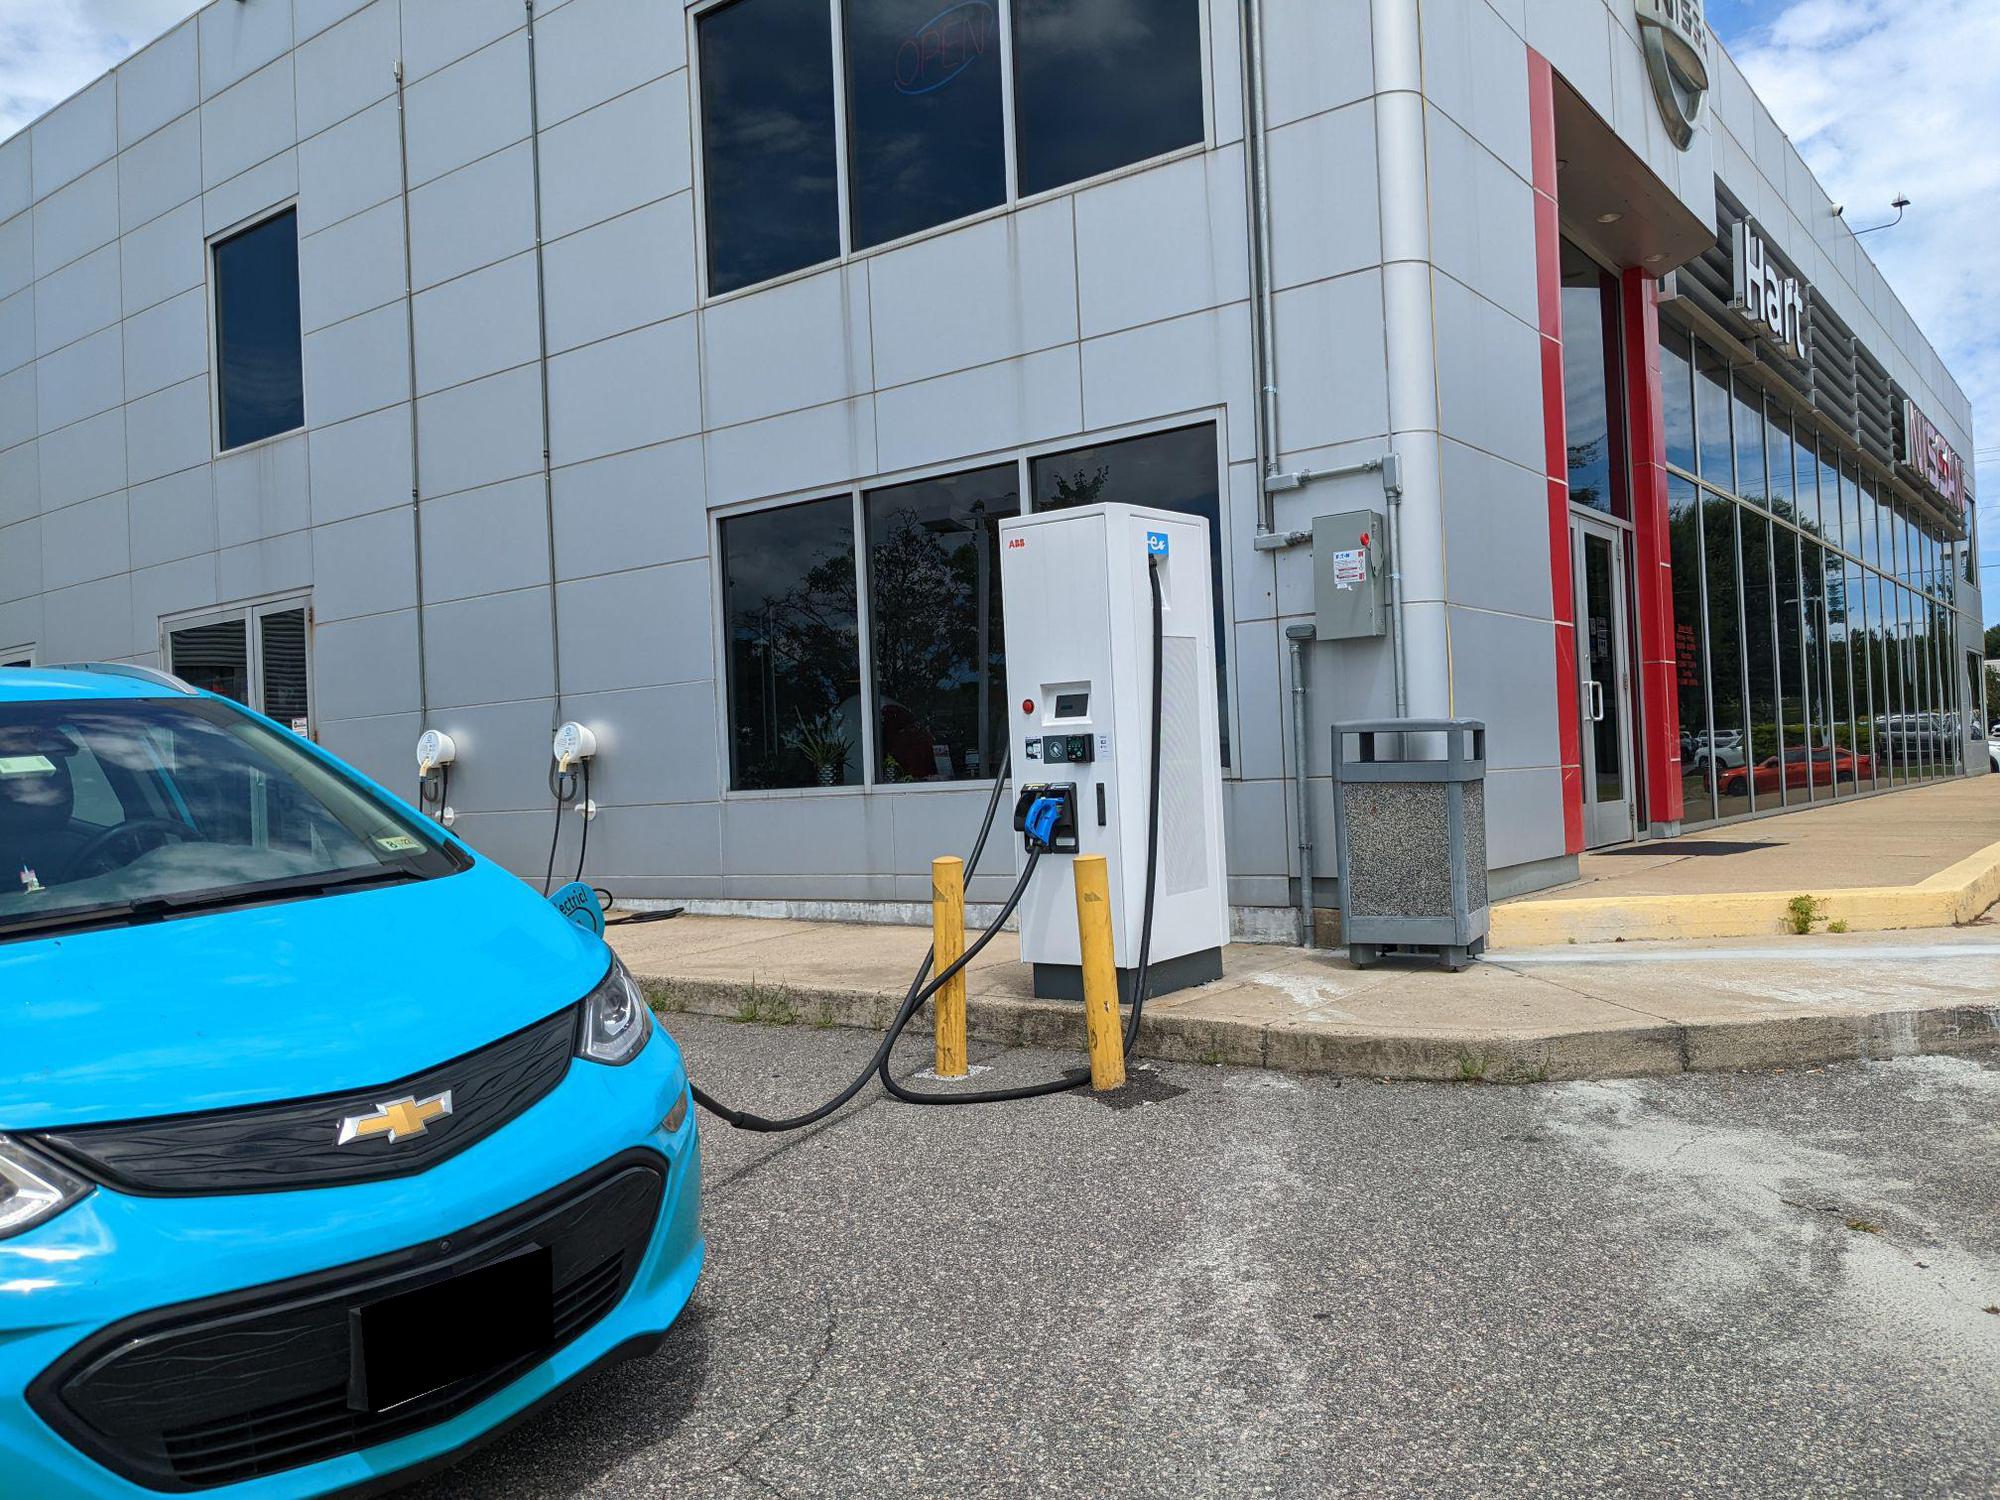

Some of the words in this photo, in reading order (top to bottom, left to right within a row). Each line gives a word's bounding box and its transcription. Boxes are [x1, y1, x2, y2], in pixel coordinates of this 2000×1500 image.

[896, 10, 984, 86] OPEN
[1734, 222, 1805, 359] Hart
[1009, 538, 1025, 549] ABB
